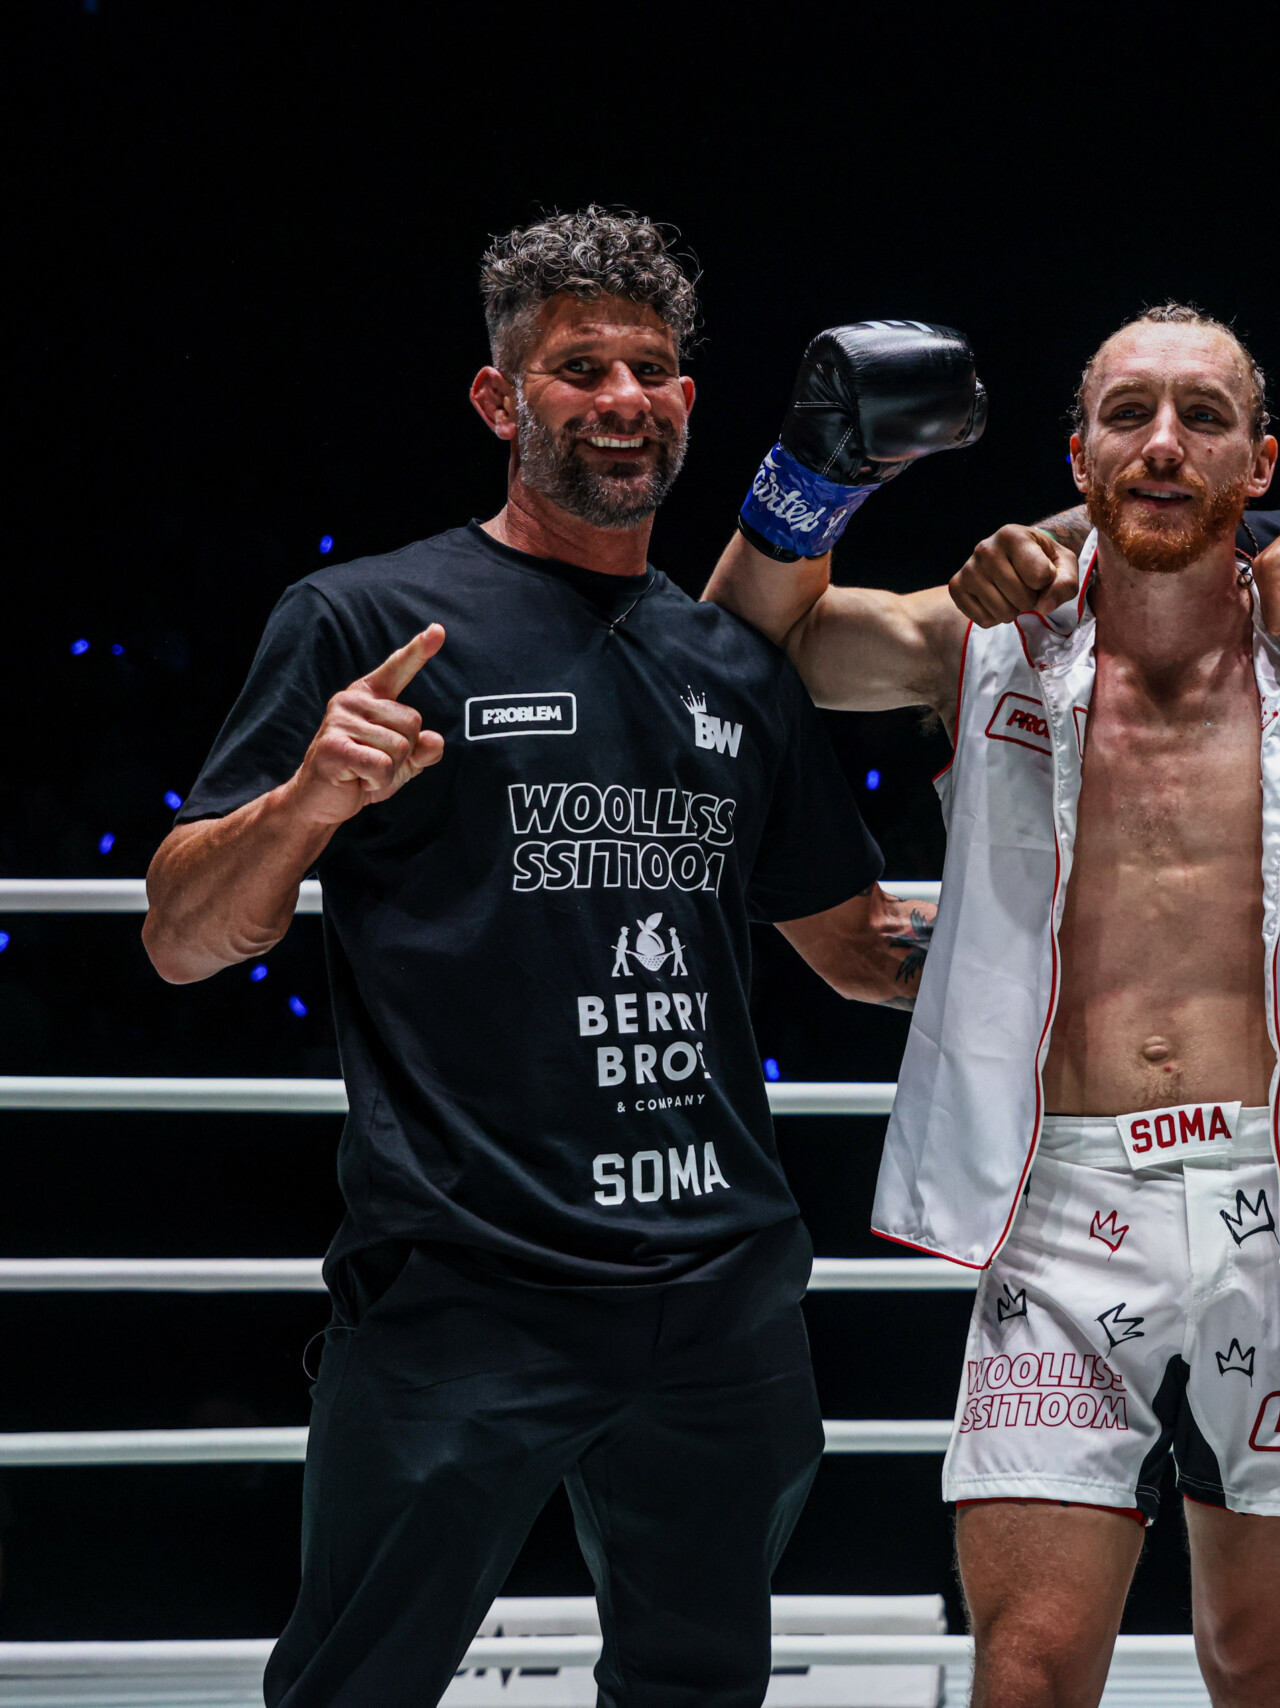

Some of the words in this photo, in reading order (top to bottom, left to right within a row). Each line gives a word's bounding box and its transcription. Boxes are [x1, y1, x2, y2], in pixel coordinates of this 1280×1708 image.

[482, 705, 562, 725] PROBLEM
[694, 712, 743, 758] BW
[577, 991, 708, 1036] BERRY
[617, 1101, 626, 1113] &
[635, 1094, 706, 1112] COMPANY
[1130, 1105, 1233, 1154] SOMA
[592, 1141, 731, 1206] SOMA
